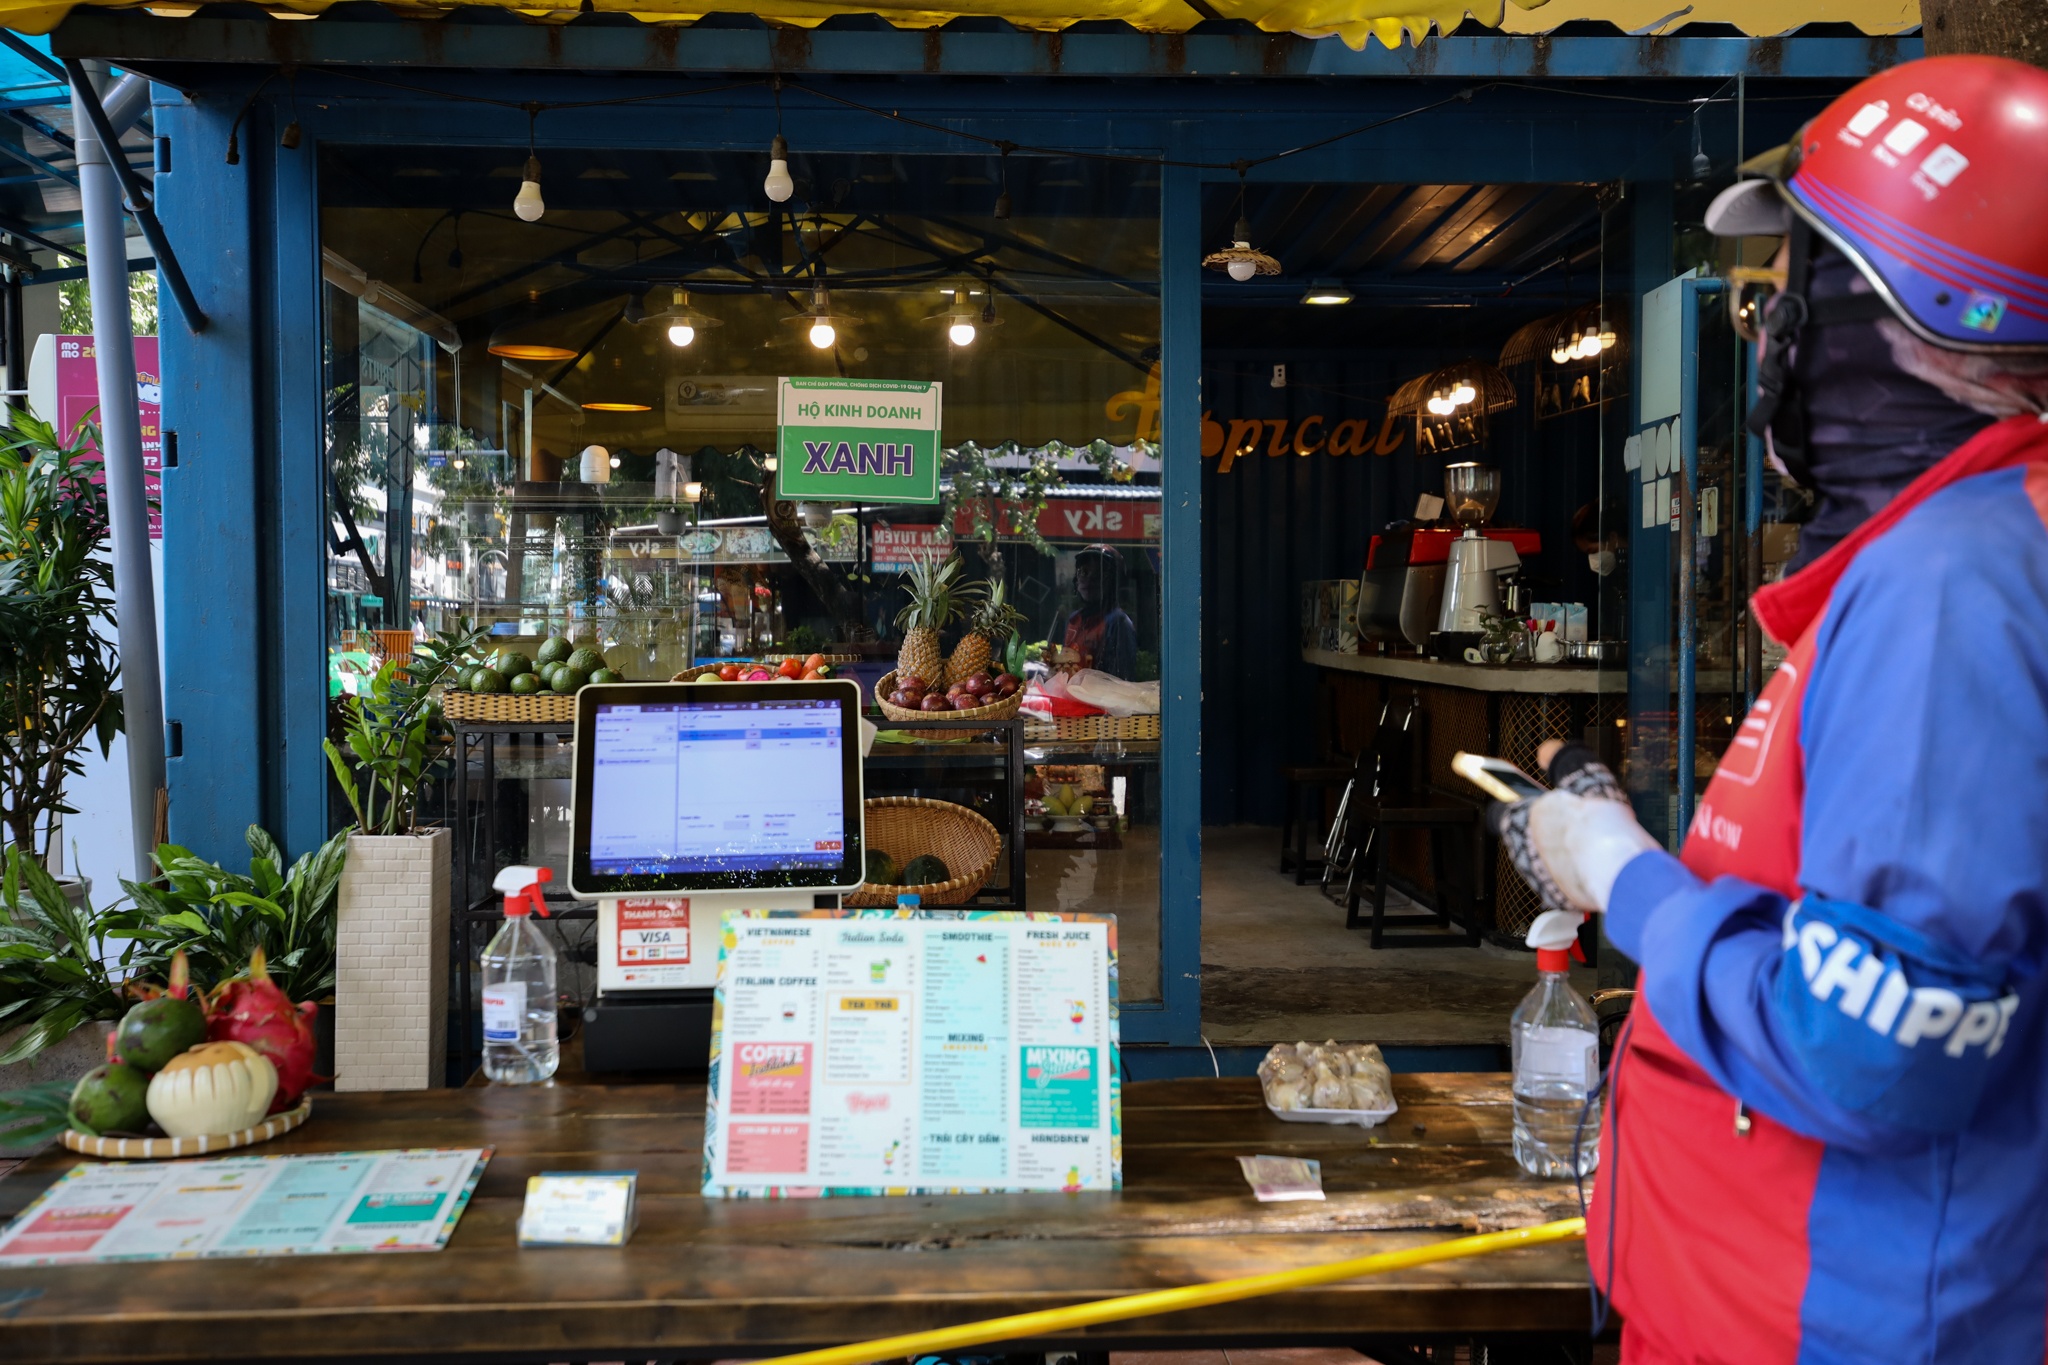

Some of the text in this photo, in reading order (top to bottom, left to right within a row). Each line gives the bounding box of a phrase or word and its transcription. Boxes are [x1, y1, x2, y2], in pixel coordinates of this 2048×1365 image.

[798, 401, 921, 420] HỘ KINH DOANH
[801, 441, 914, 476] XANH
[640, 932, 671, 943] VISA
[746, 928, 812, 936] VIETNAMESE
[840, 931, 905, 943] Italian Soda
[942, 932, 994, 942] SMOOTHIE
[1026, 930, 1092, 940] FRESH JUICE
[734, 976, 818, 986] ITALIAN COFFEE
[948, 1034, 984, 1042] MIXING
[740, 1045, 805, 1063] COFFEE
[1026, 1048, 1091, 1066] MIXING
[1031, 1133, 1090, 1144] HANDBREW
